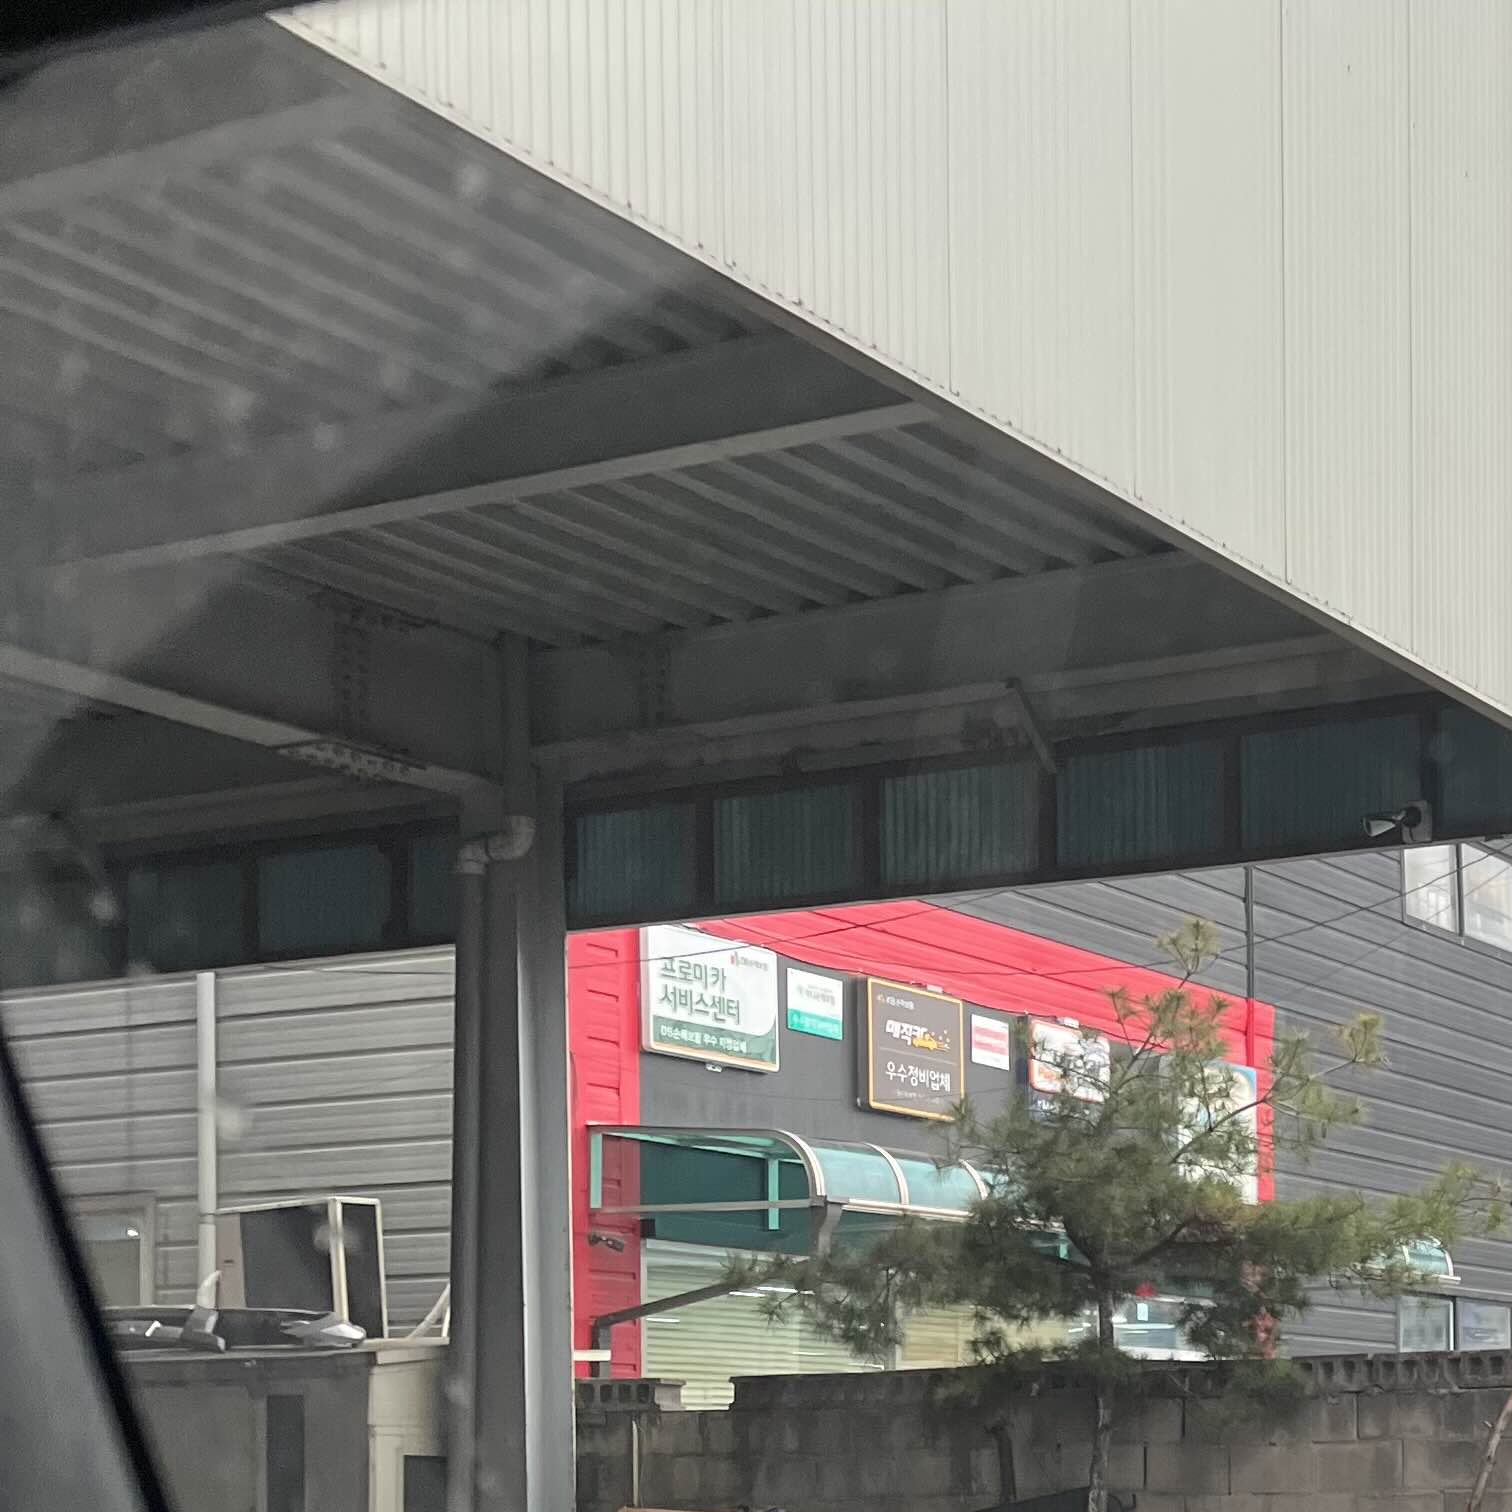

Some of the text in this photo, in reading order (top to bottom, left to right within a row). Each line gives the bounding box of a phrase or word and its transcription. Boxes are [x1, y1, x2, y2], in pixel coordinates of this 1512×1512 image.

[660, 957, 727, 991] 프로미카
[660, 983, 740, 1025] 서비스센터
[885, 1060, 951, 1092] 우수정비업체
